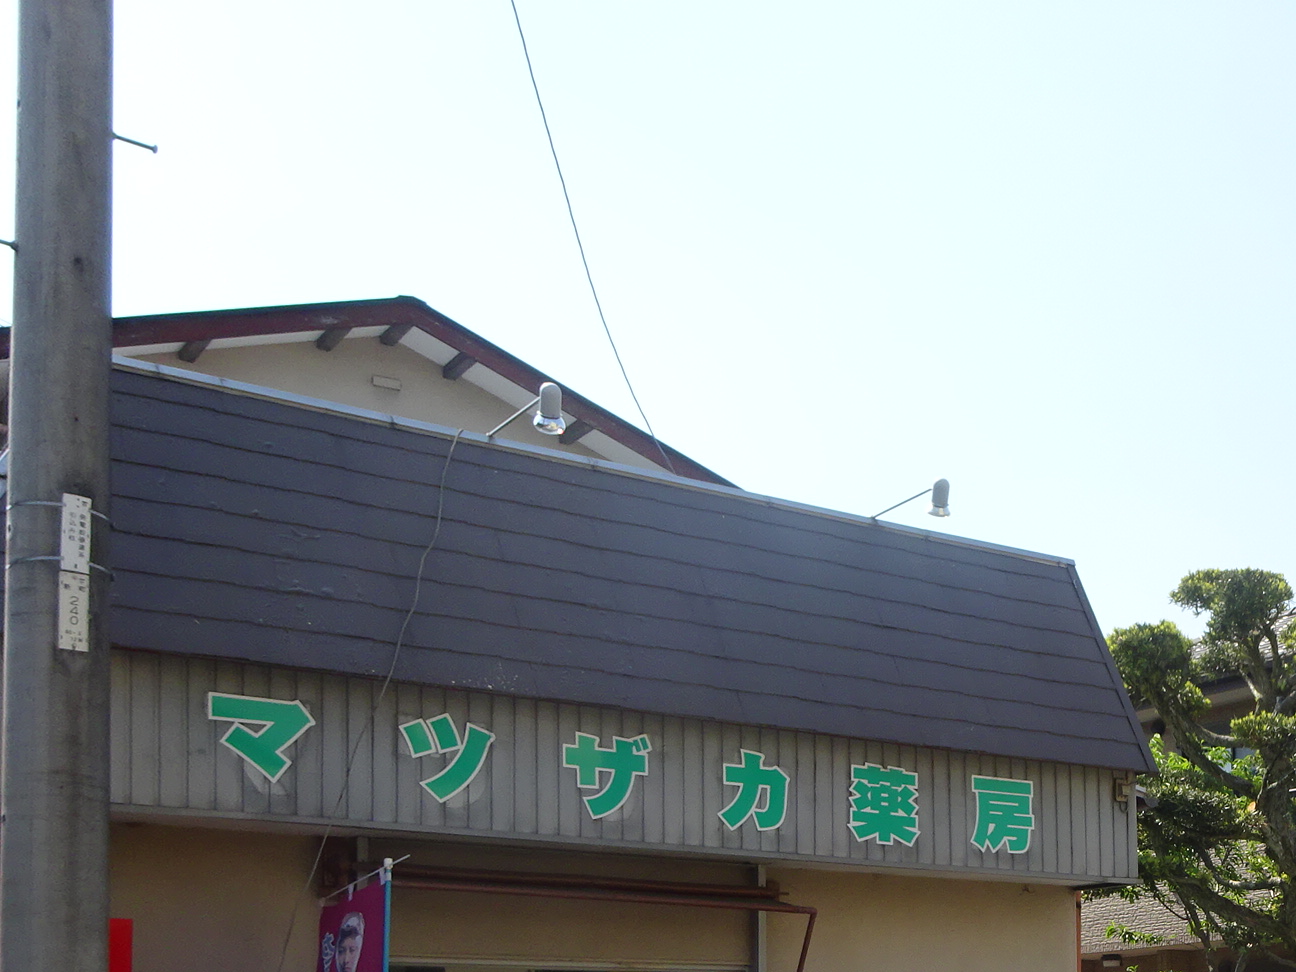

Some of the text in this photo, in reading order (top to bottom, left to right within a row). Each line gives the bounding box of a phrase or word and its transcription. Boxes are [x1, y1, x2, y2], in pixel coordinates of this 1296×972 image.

[69, 595, 79, 626] 240
[208, 691, 1036, 854] マツザカ薬房
